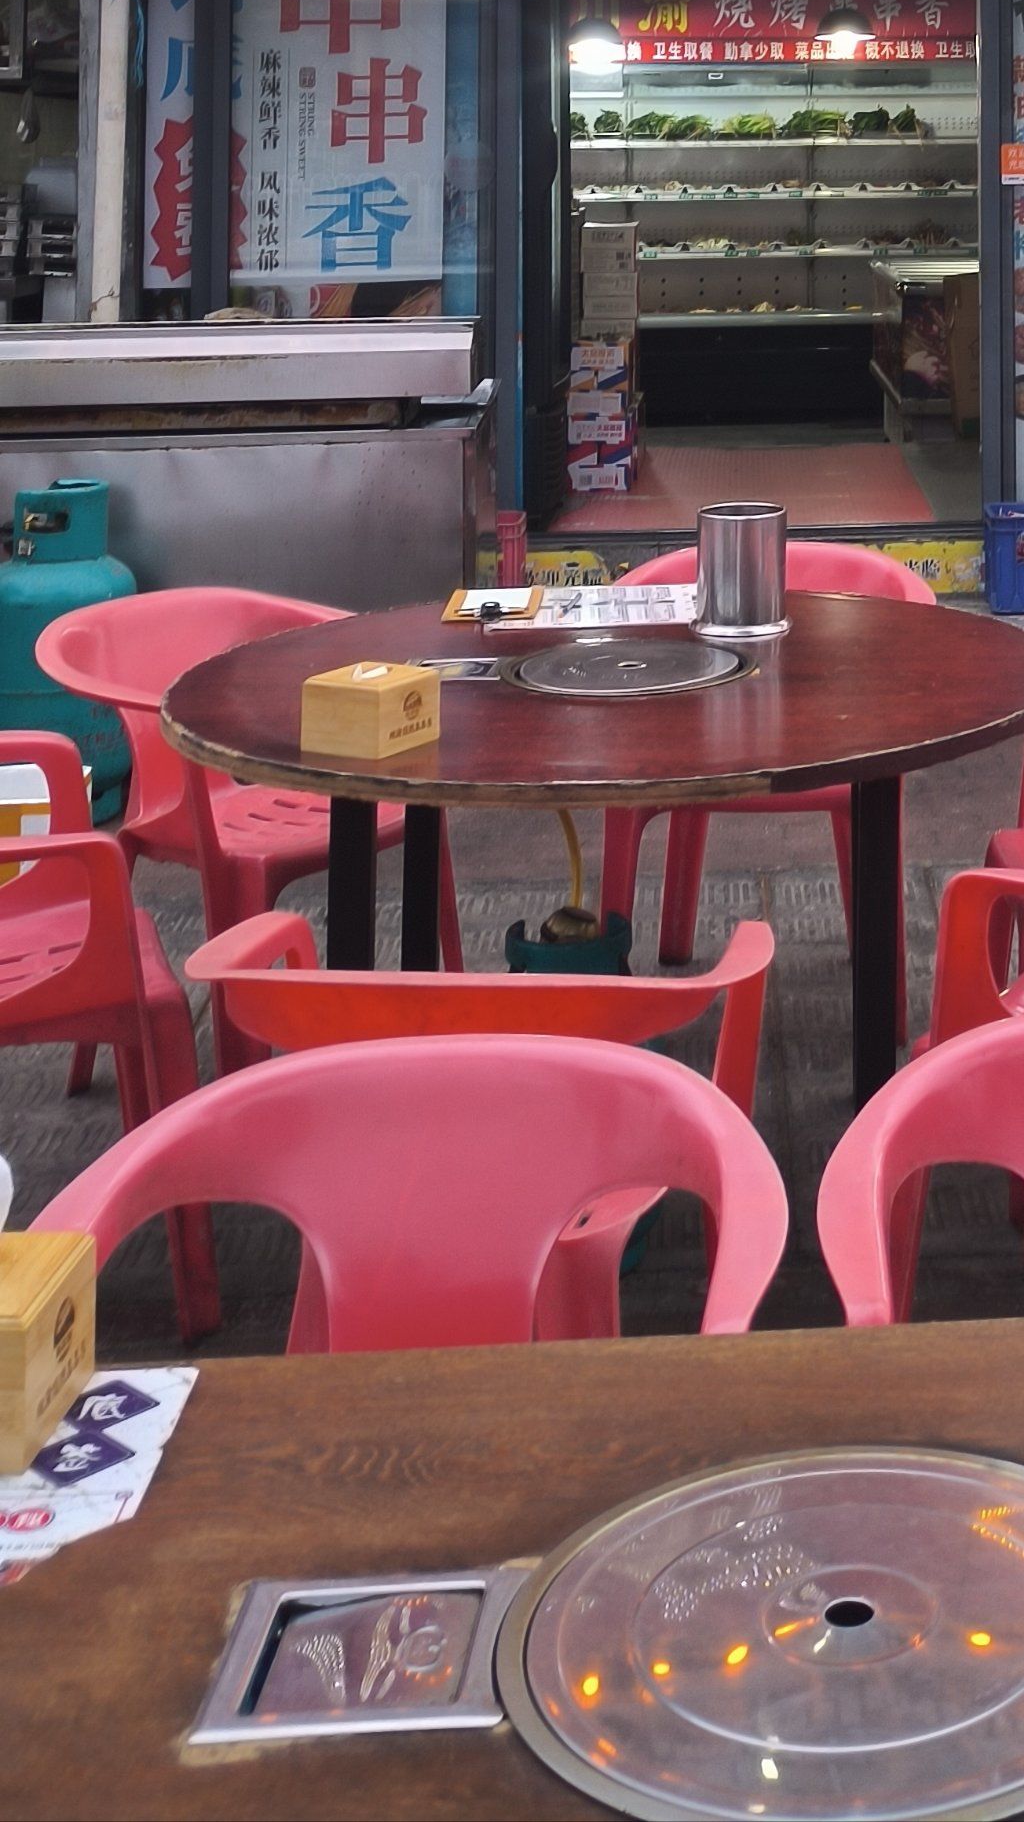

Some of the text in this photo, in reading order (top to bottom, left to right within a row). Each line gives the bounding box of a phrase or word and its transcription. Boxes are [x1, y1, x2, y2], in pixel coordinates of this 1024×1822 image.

[653, 40, 713, 61] 卫生取餐
[864, 40, 925, 61] 概不退换
[256, 48, 281, 272] 麻辣鲜香 风味浓郁
